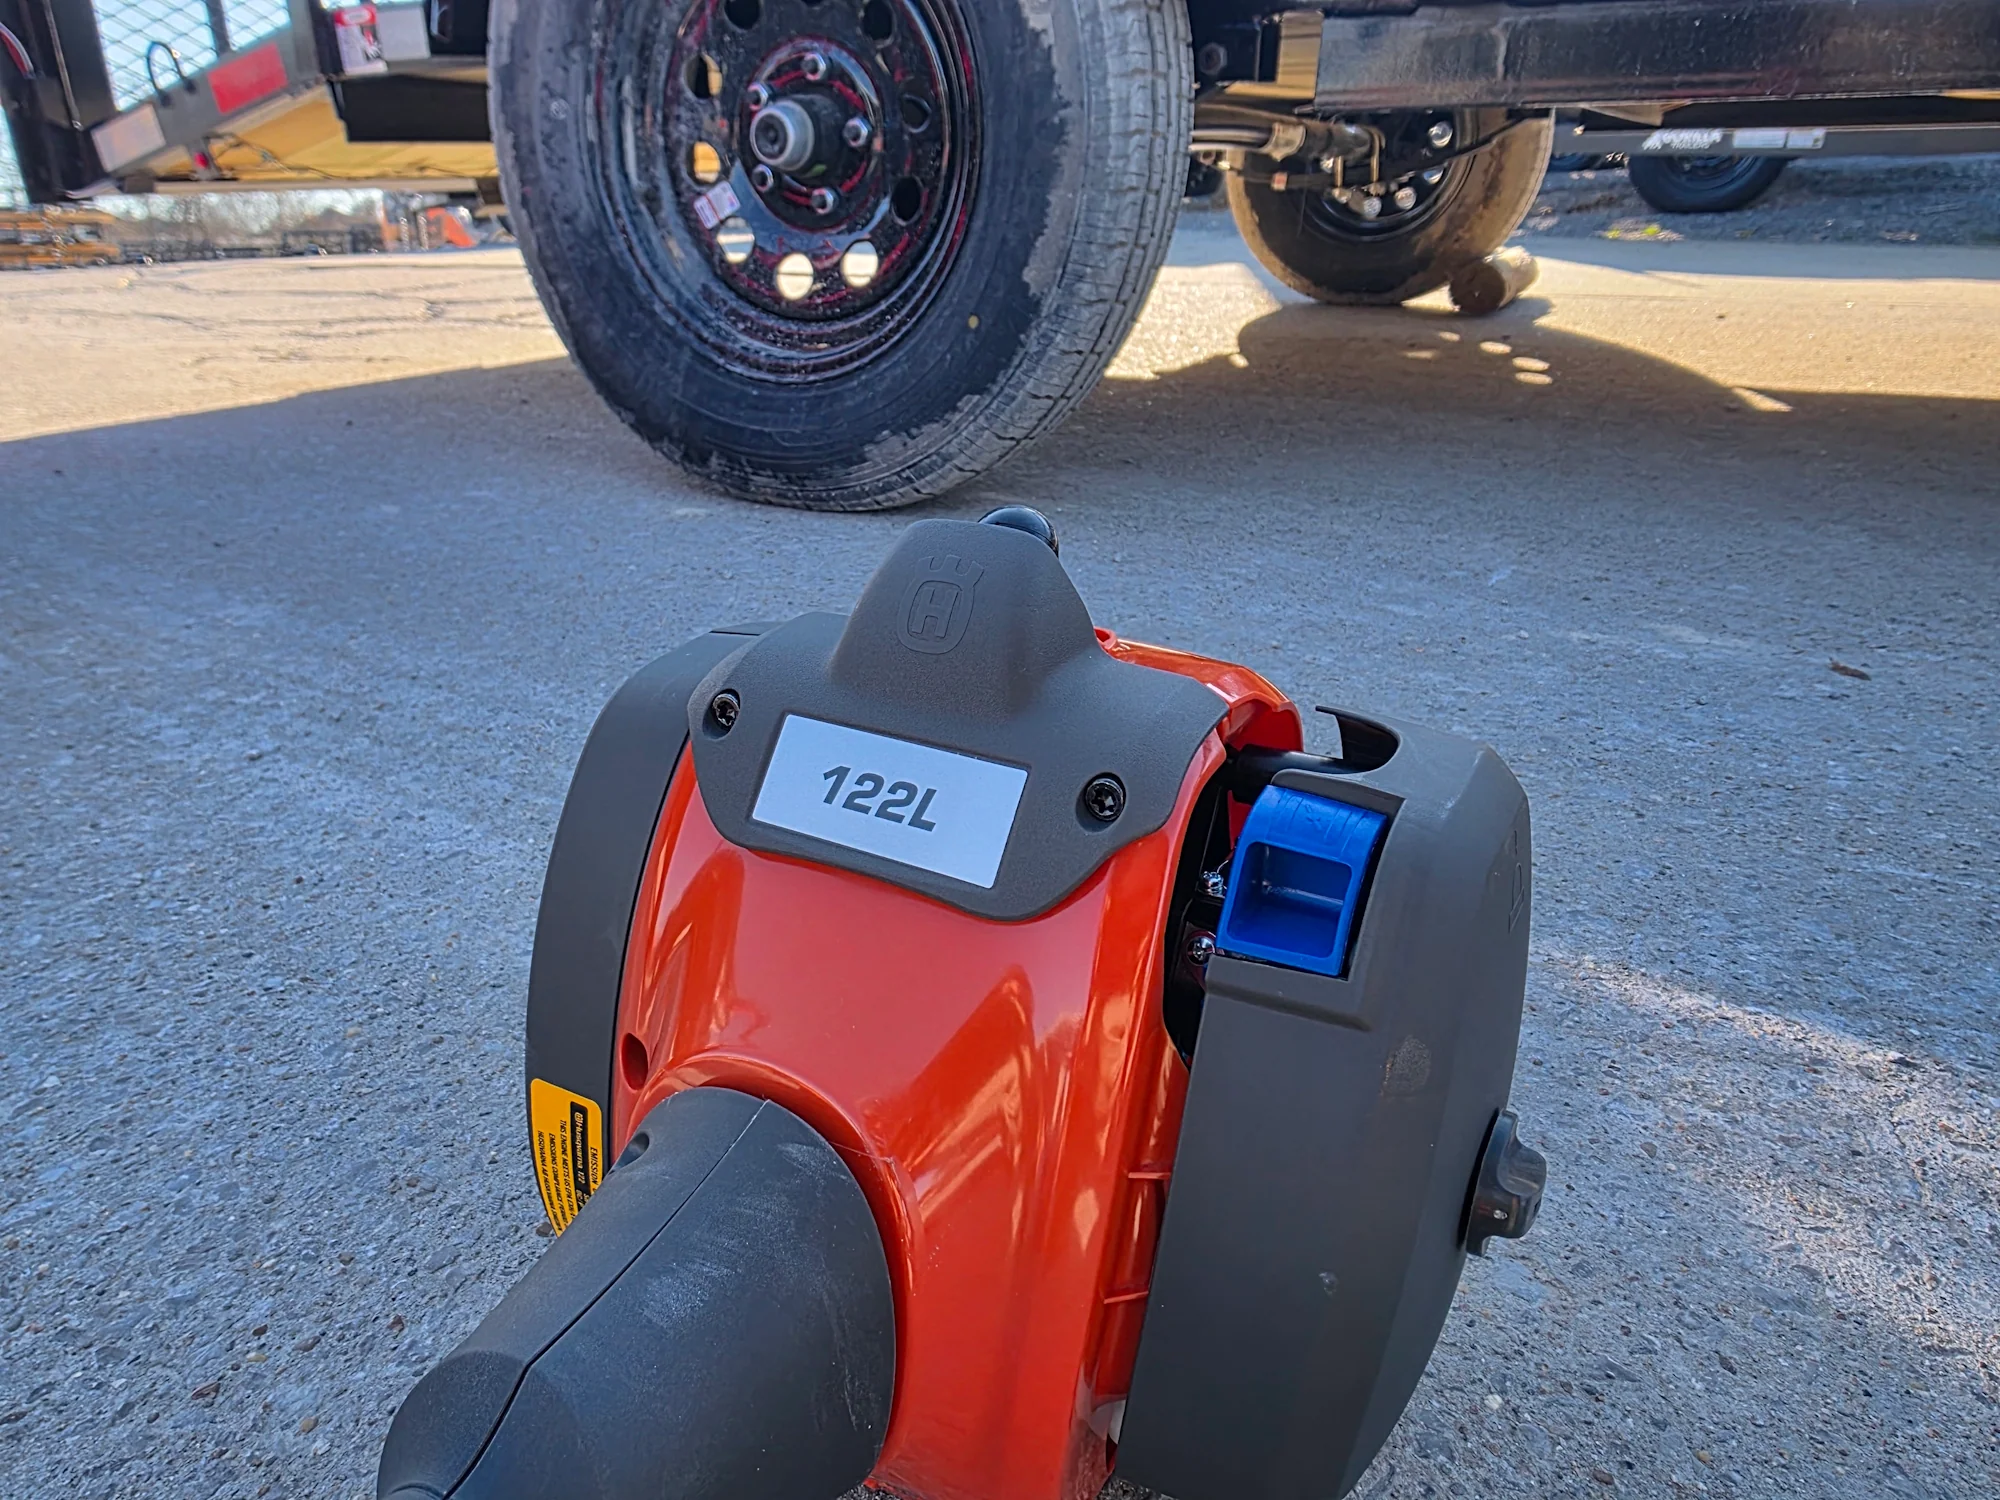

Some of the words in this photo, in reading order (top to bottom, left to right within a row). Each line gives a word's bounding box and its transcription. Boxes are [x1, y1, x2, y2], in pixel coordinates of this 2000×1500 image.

[823, 765, 937, 832] 122L
[575, 1119, 583, 1169] Husqvarna
[590, 1146, 599, 1185] EMISSION
